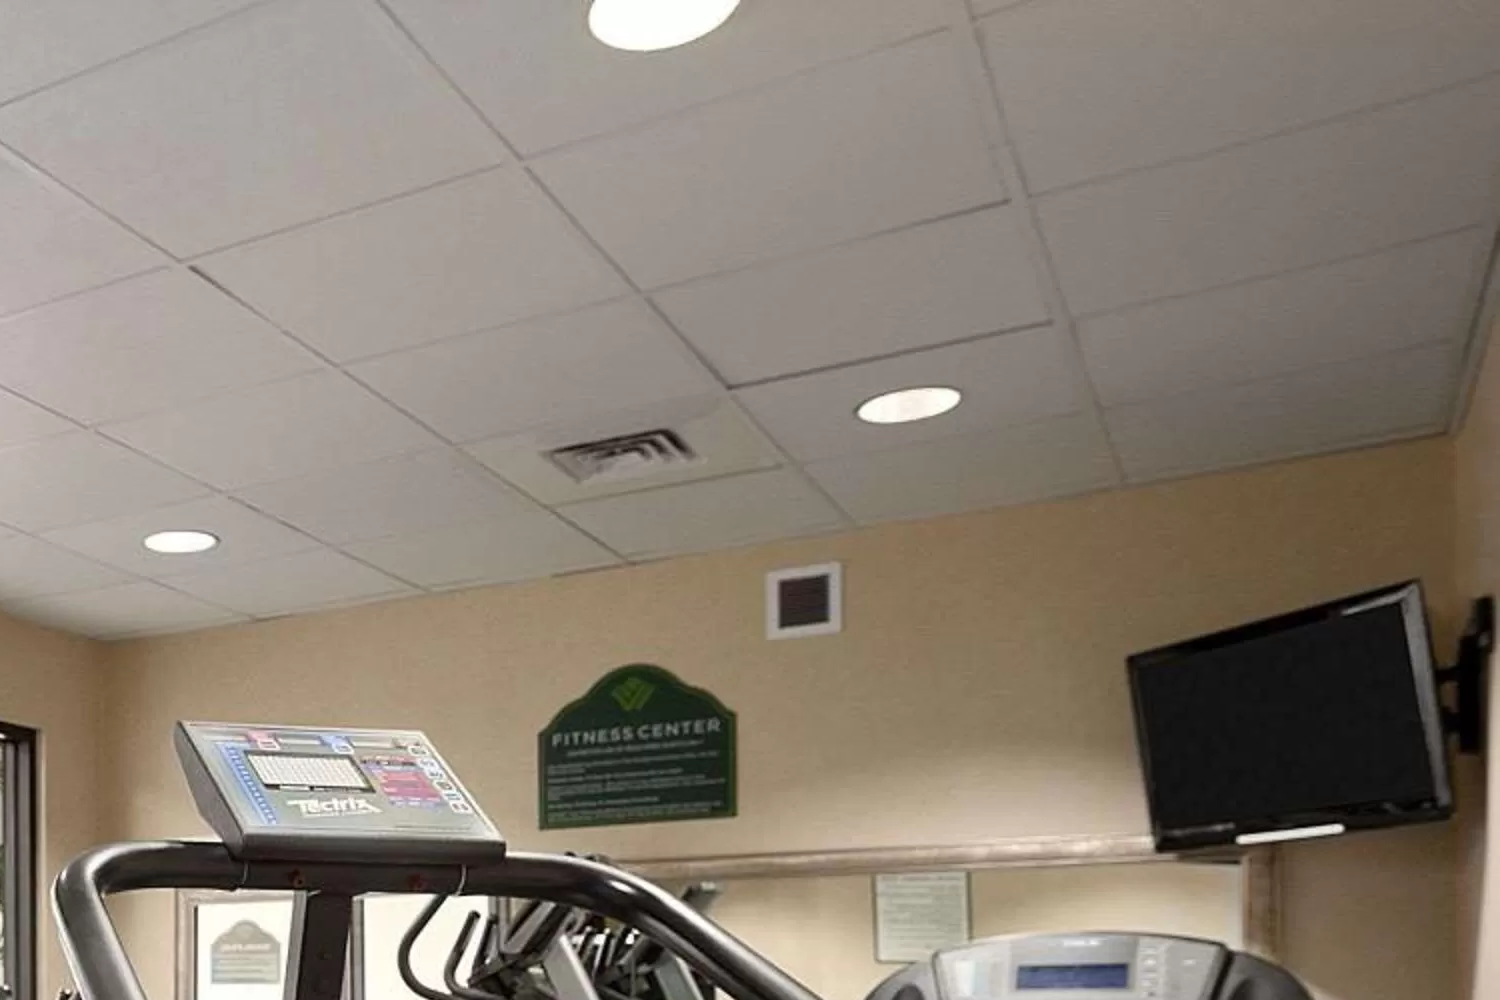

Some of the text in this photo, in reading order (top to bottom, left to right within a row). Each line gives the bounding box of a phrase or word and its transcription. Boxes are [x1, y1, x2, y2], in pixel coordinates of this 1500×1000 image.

[552, 716, 721, 747] FITNESS CENTER
[286, 797, 383, 814] Tectrix
